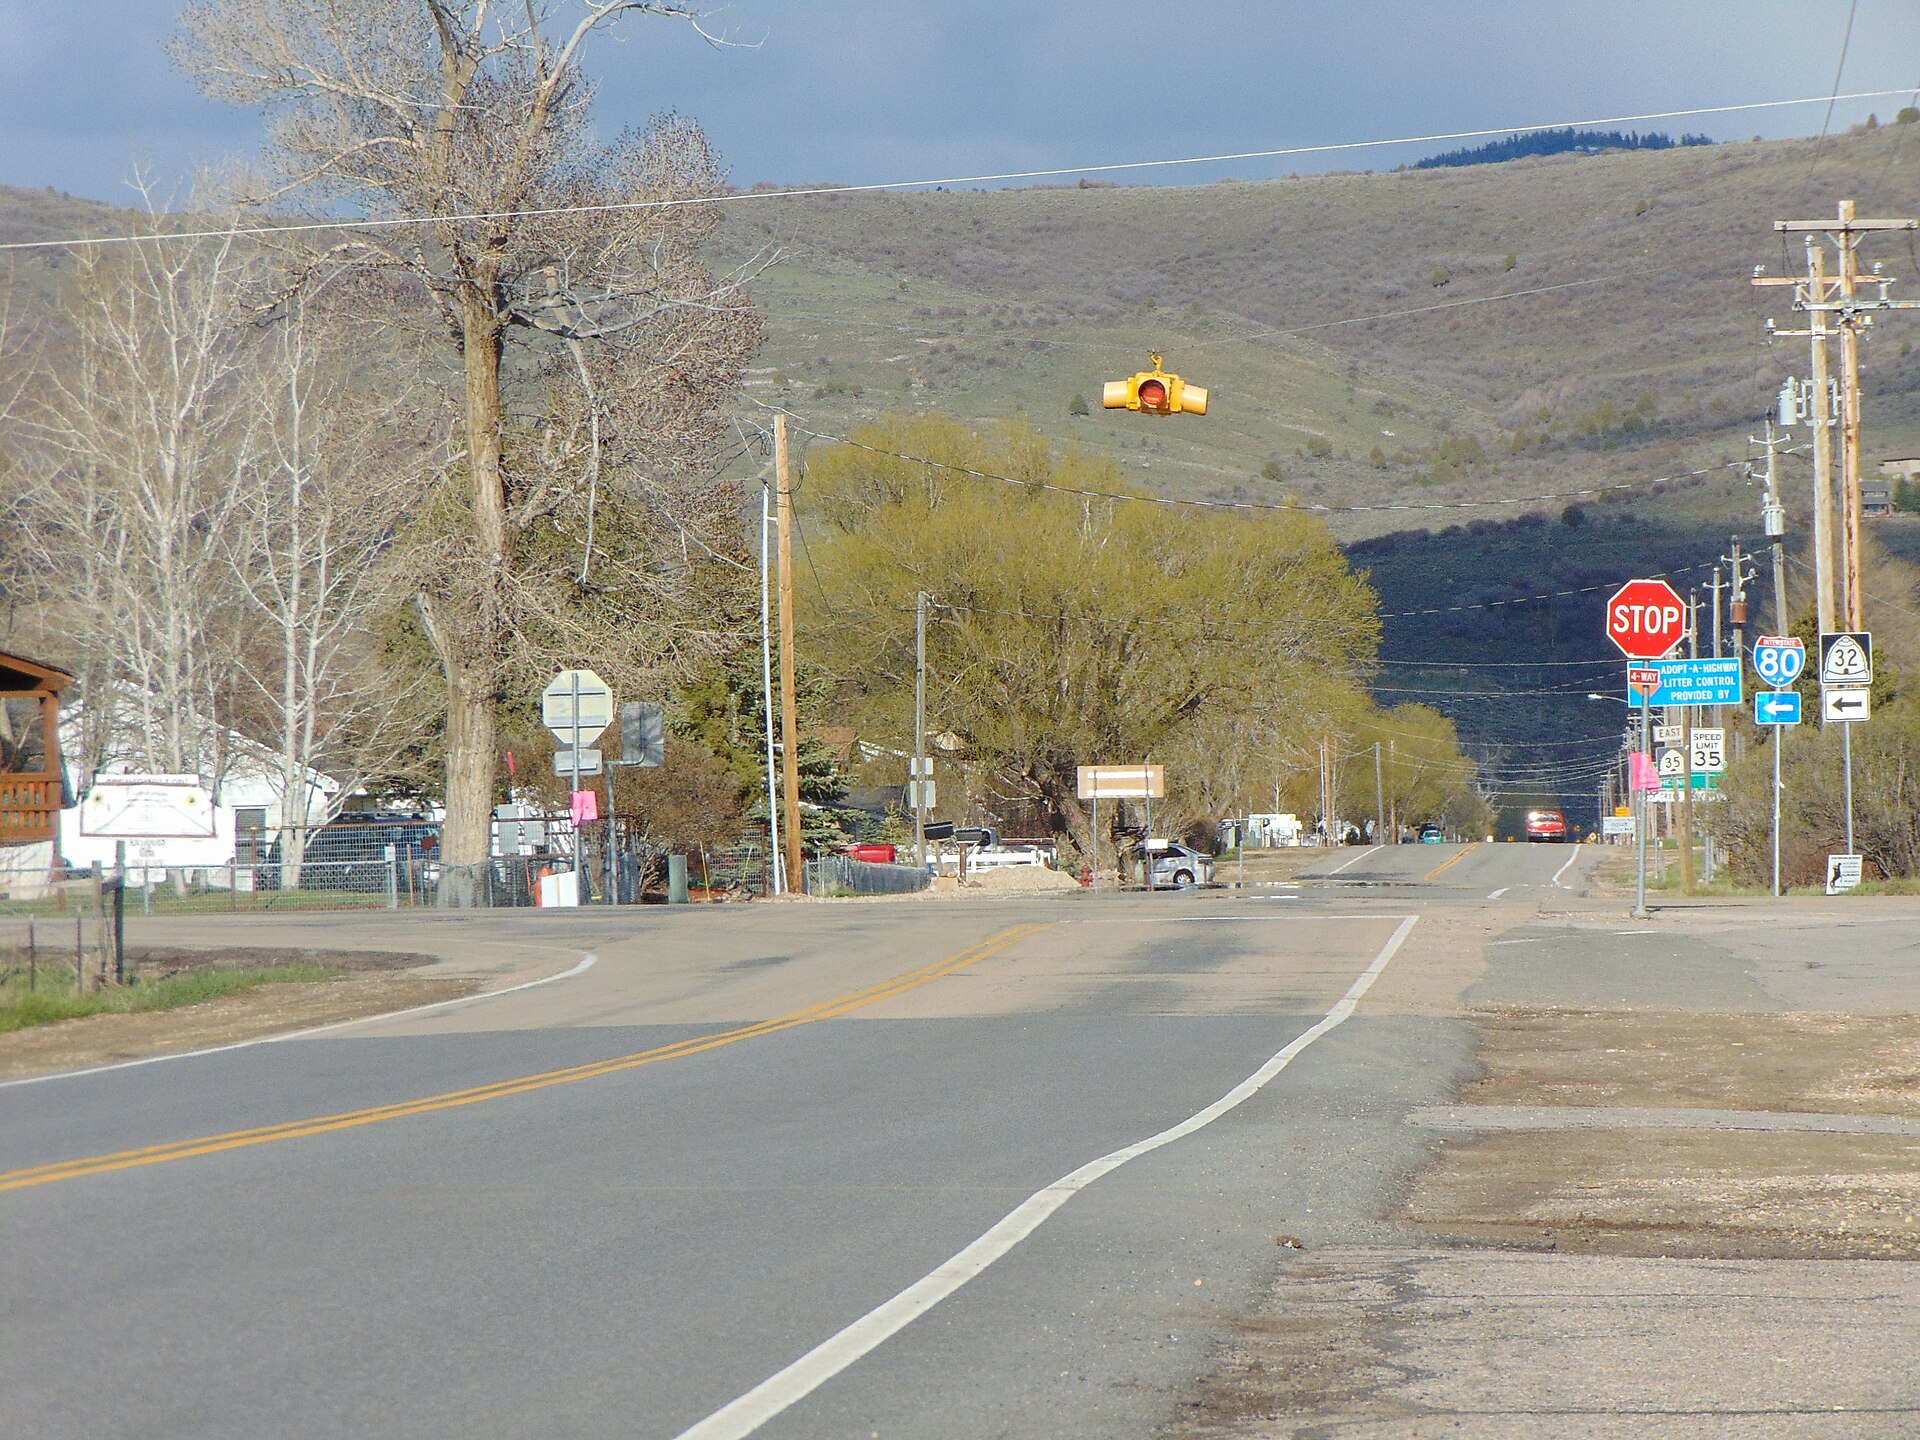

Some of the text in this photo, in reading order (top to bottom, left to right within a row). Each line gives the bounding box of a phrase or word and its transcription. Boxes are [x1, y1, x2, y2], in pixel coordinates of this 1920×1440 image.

[1613, 604, 1680, 635] STOP
[1763, 638, 1797, 647] INTERSTATE
[1759, 648, 1801, 678] 80
[1834, 648, 1858, 667] 32
[1630, 671, 1657, 682] 4-WAY
[1663, 676, 1737, 688] LITTER CONTROL
[1671, 689, 1730, 701] PROVIDED BY
[1659, 729, 1682, 738] EAST
[1693, 733, 1722, 741] SPEED
[1696, 742, 1719, 750] LIMIT
[1665, 756, 1681, 769] 35
[1694, 751, 1721, 767] 35
